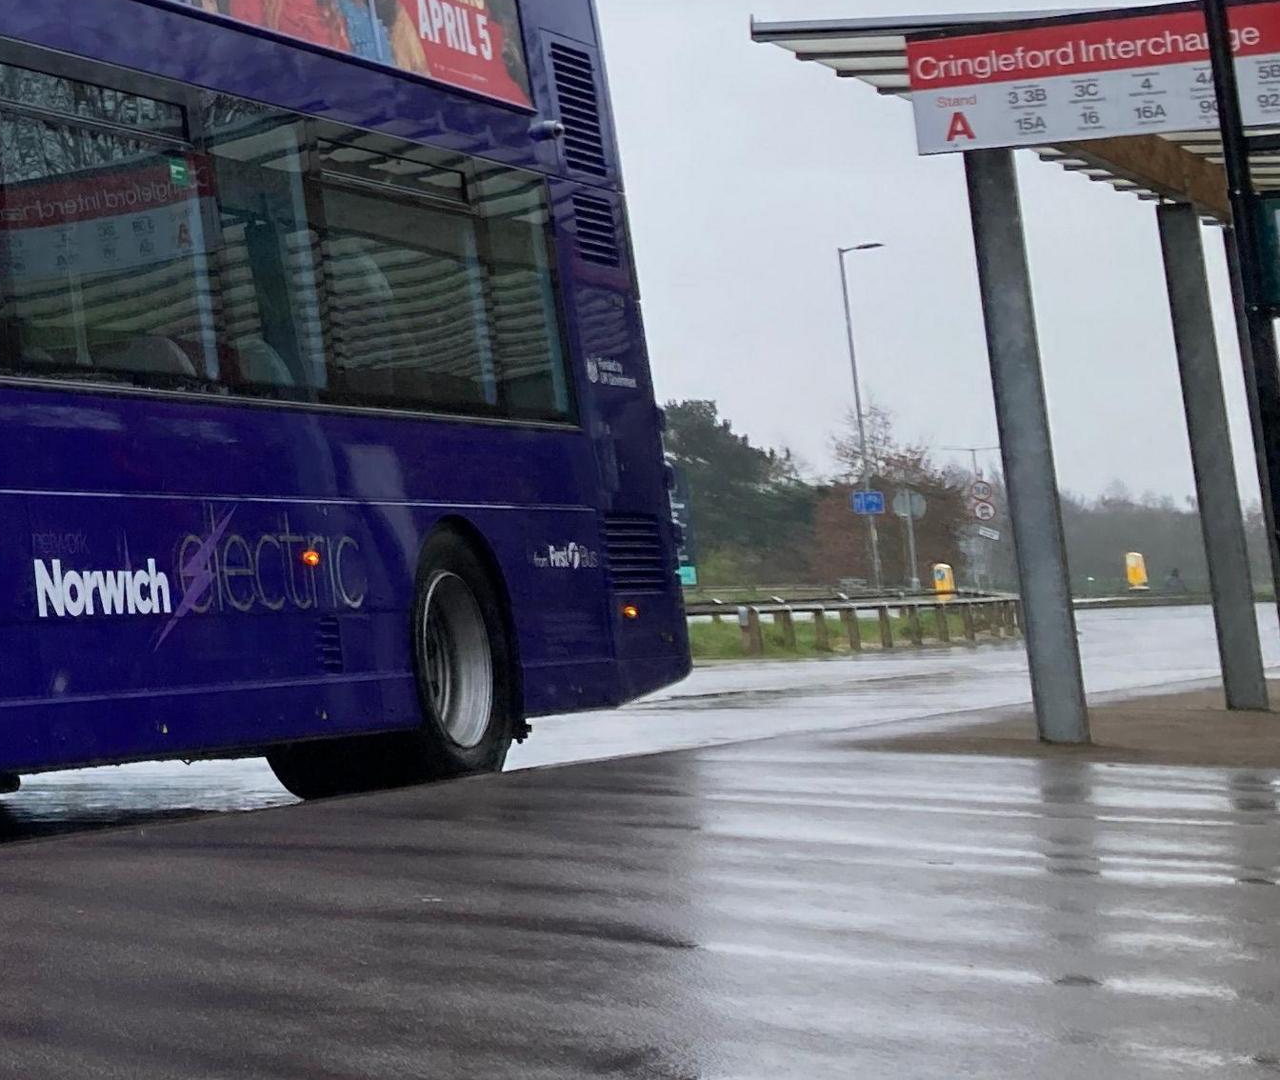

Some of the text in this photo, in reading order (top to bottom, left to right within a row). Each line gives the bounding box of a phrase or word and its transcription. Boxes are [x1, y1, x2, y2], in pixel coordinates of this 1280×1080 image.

[476, 13, 493, 61] 5
[916, 41, 1075, 80] Cringleford
[1074, 83, 1099, 98] 3C
[1141, 78, 1153, 90] 4
[936, 93, 978, 108] Stand
[1008, 88, 1047, 105] 3 3B
[1080, 111, 1100, 124] 16
[1134, 104, 1167, 119] 16A
[946, 111, 977, 142] A
[1015, 115, 1048, 131] 15A
[34, 503, 365, 618] Norwich electric
